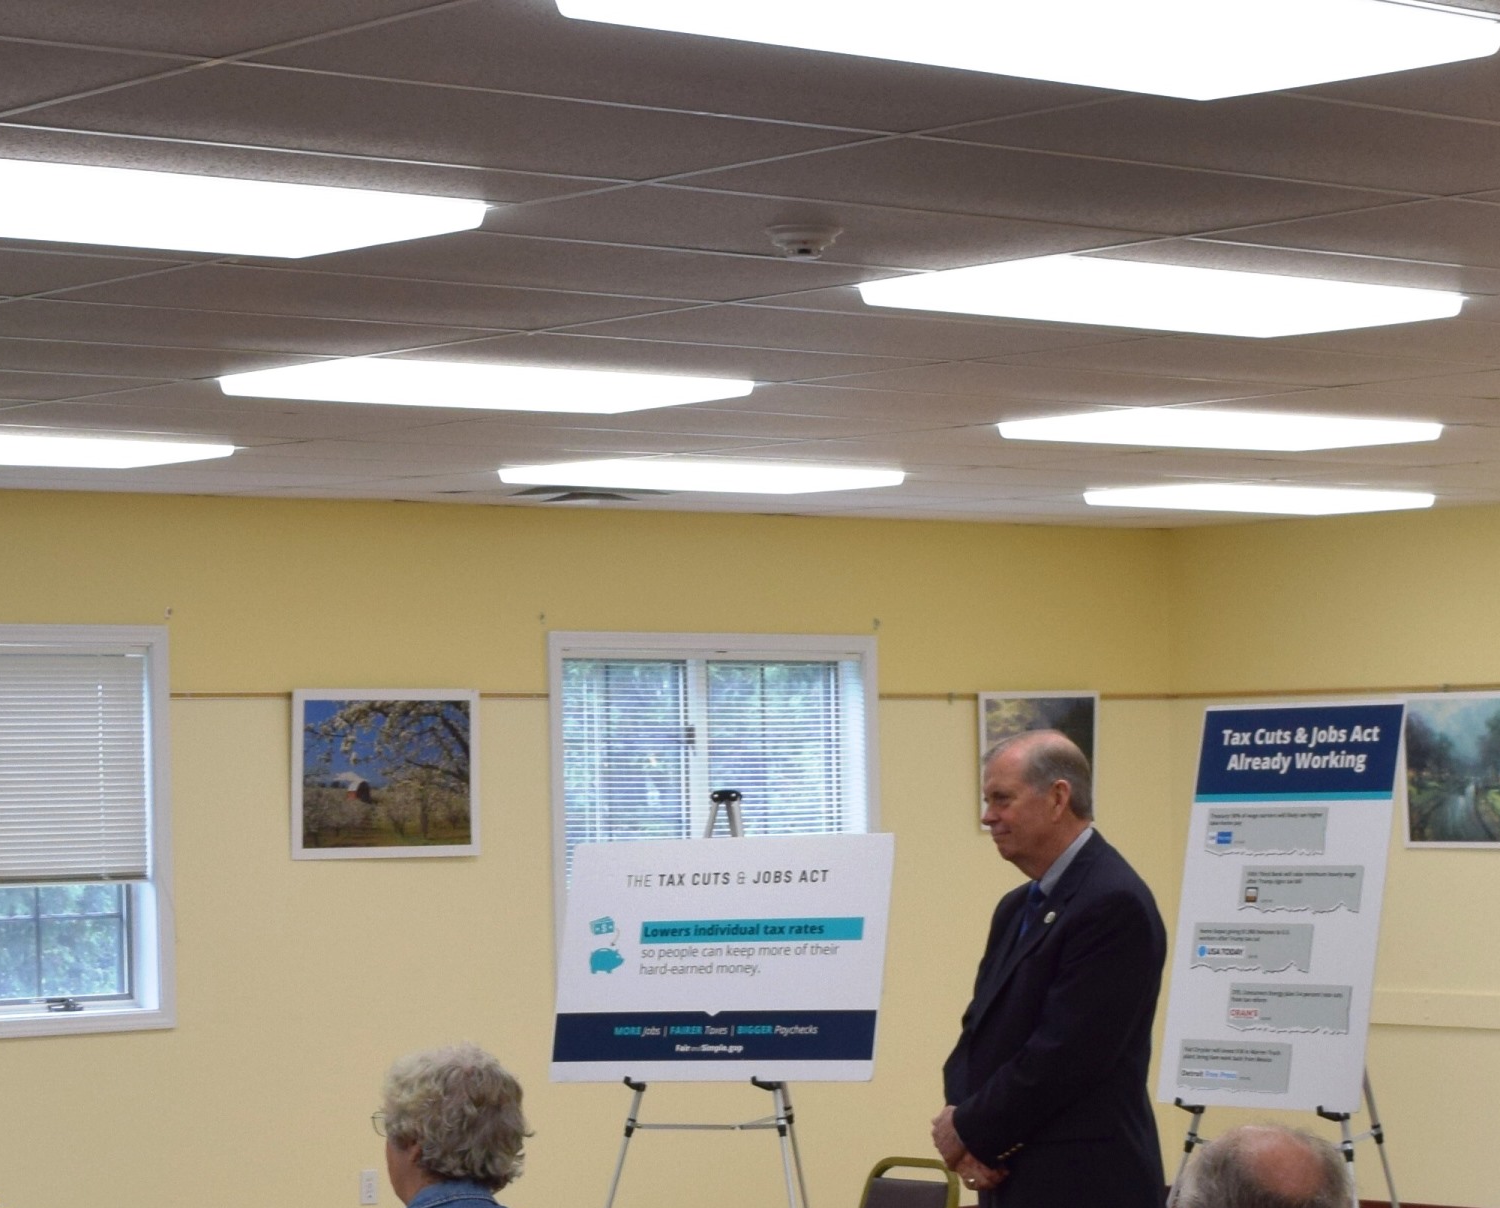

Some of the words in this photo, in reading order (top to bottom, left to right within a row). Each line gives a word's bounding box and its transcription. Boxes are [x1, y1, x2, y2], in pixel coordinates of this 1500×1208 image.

[1222, 728, 1251, 747] Tax
[1255, 727, 1292, 745] Cuts
[1295, 727, 1307, 744] &
[1309, 726, 1347, 748] Jobs
[1351, 725, 1380, 743] Act
[1227, 752, 1291, 774] Already
[1295, 750, 1367, 773] Working
[627, 874, 652, 888] THE
[658, 873, 686, 887] TAX
[692, 872, 731, 886] CUTS
[737, 871, 746, 885] &
[753, 870, 793, 884] JOBS
[799, 869, 829, 883] ACT
[644, 925, 692, 939] Lowers
[694, 923, 761, 938] individual
[764, 924, 786, 937] tax
[789, 923, 825, 936] rates
[641, 948, 656, 959] so
[657, 945, 699, 961] people
[701, 947, 723, 958] can
[726, 944, 755, 960] keep
[758, 946, 791, 957] more
[793, 943, 809, 957] of
[810, 943, 840, 956] their
[639, 962, 713, 976] hard-earned
[716, 963, 761, 978] money.
[614, 1026, 641, 1035] MORE
[641, 1026, 661, 1037] Jobs
[704, 1025, 728, 1035] Taxes
[737, 1025, 772, 1035] BIGGER
[774, 1025, 818, 1037] Paychecks
